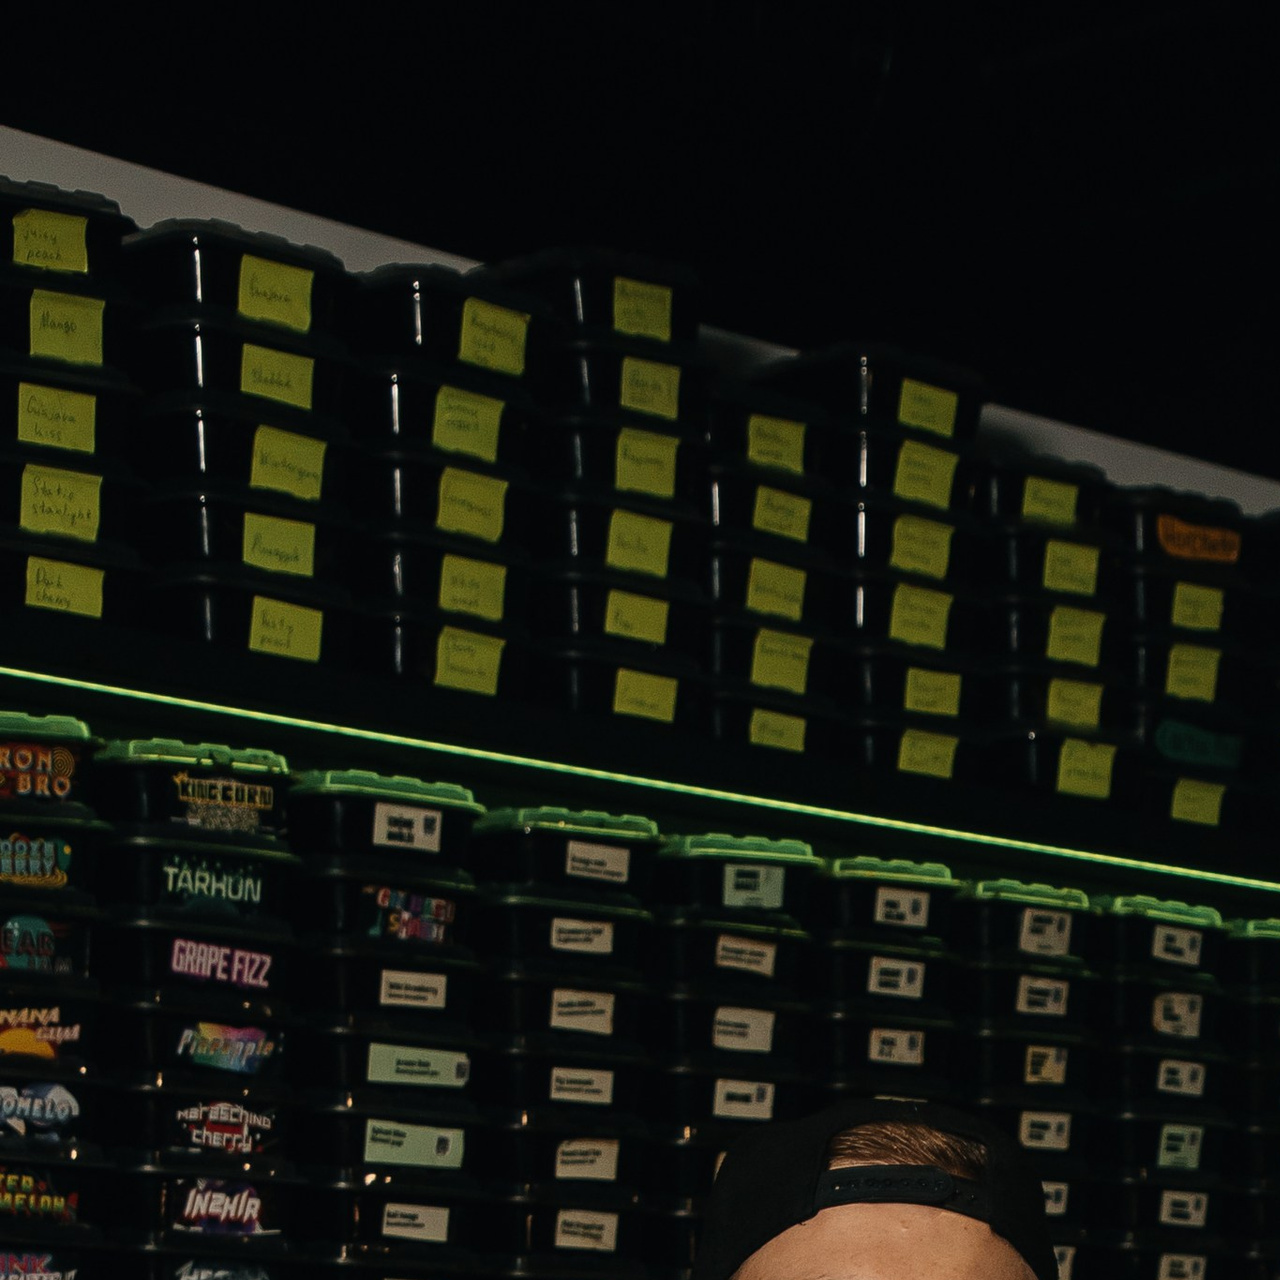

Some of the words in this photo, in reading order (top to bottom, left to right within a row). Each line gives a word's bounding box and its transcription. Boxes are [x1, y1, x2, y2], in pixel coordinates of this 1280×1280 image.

[16, 775, 71, 797] BRO
[163, 866, 262, 904] TARHUN
[171, 937, 232, 981] GRAPE
[231, 949, 272, 989] FIZZ
[176, 1028, 275, 1066] Pineapple
[184, 1187, 262, 1222] INZHIR
